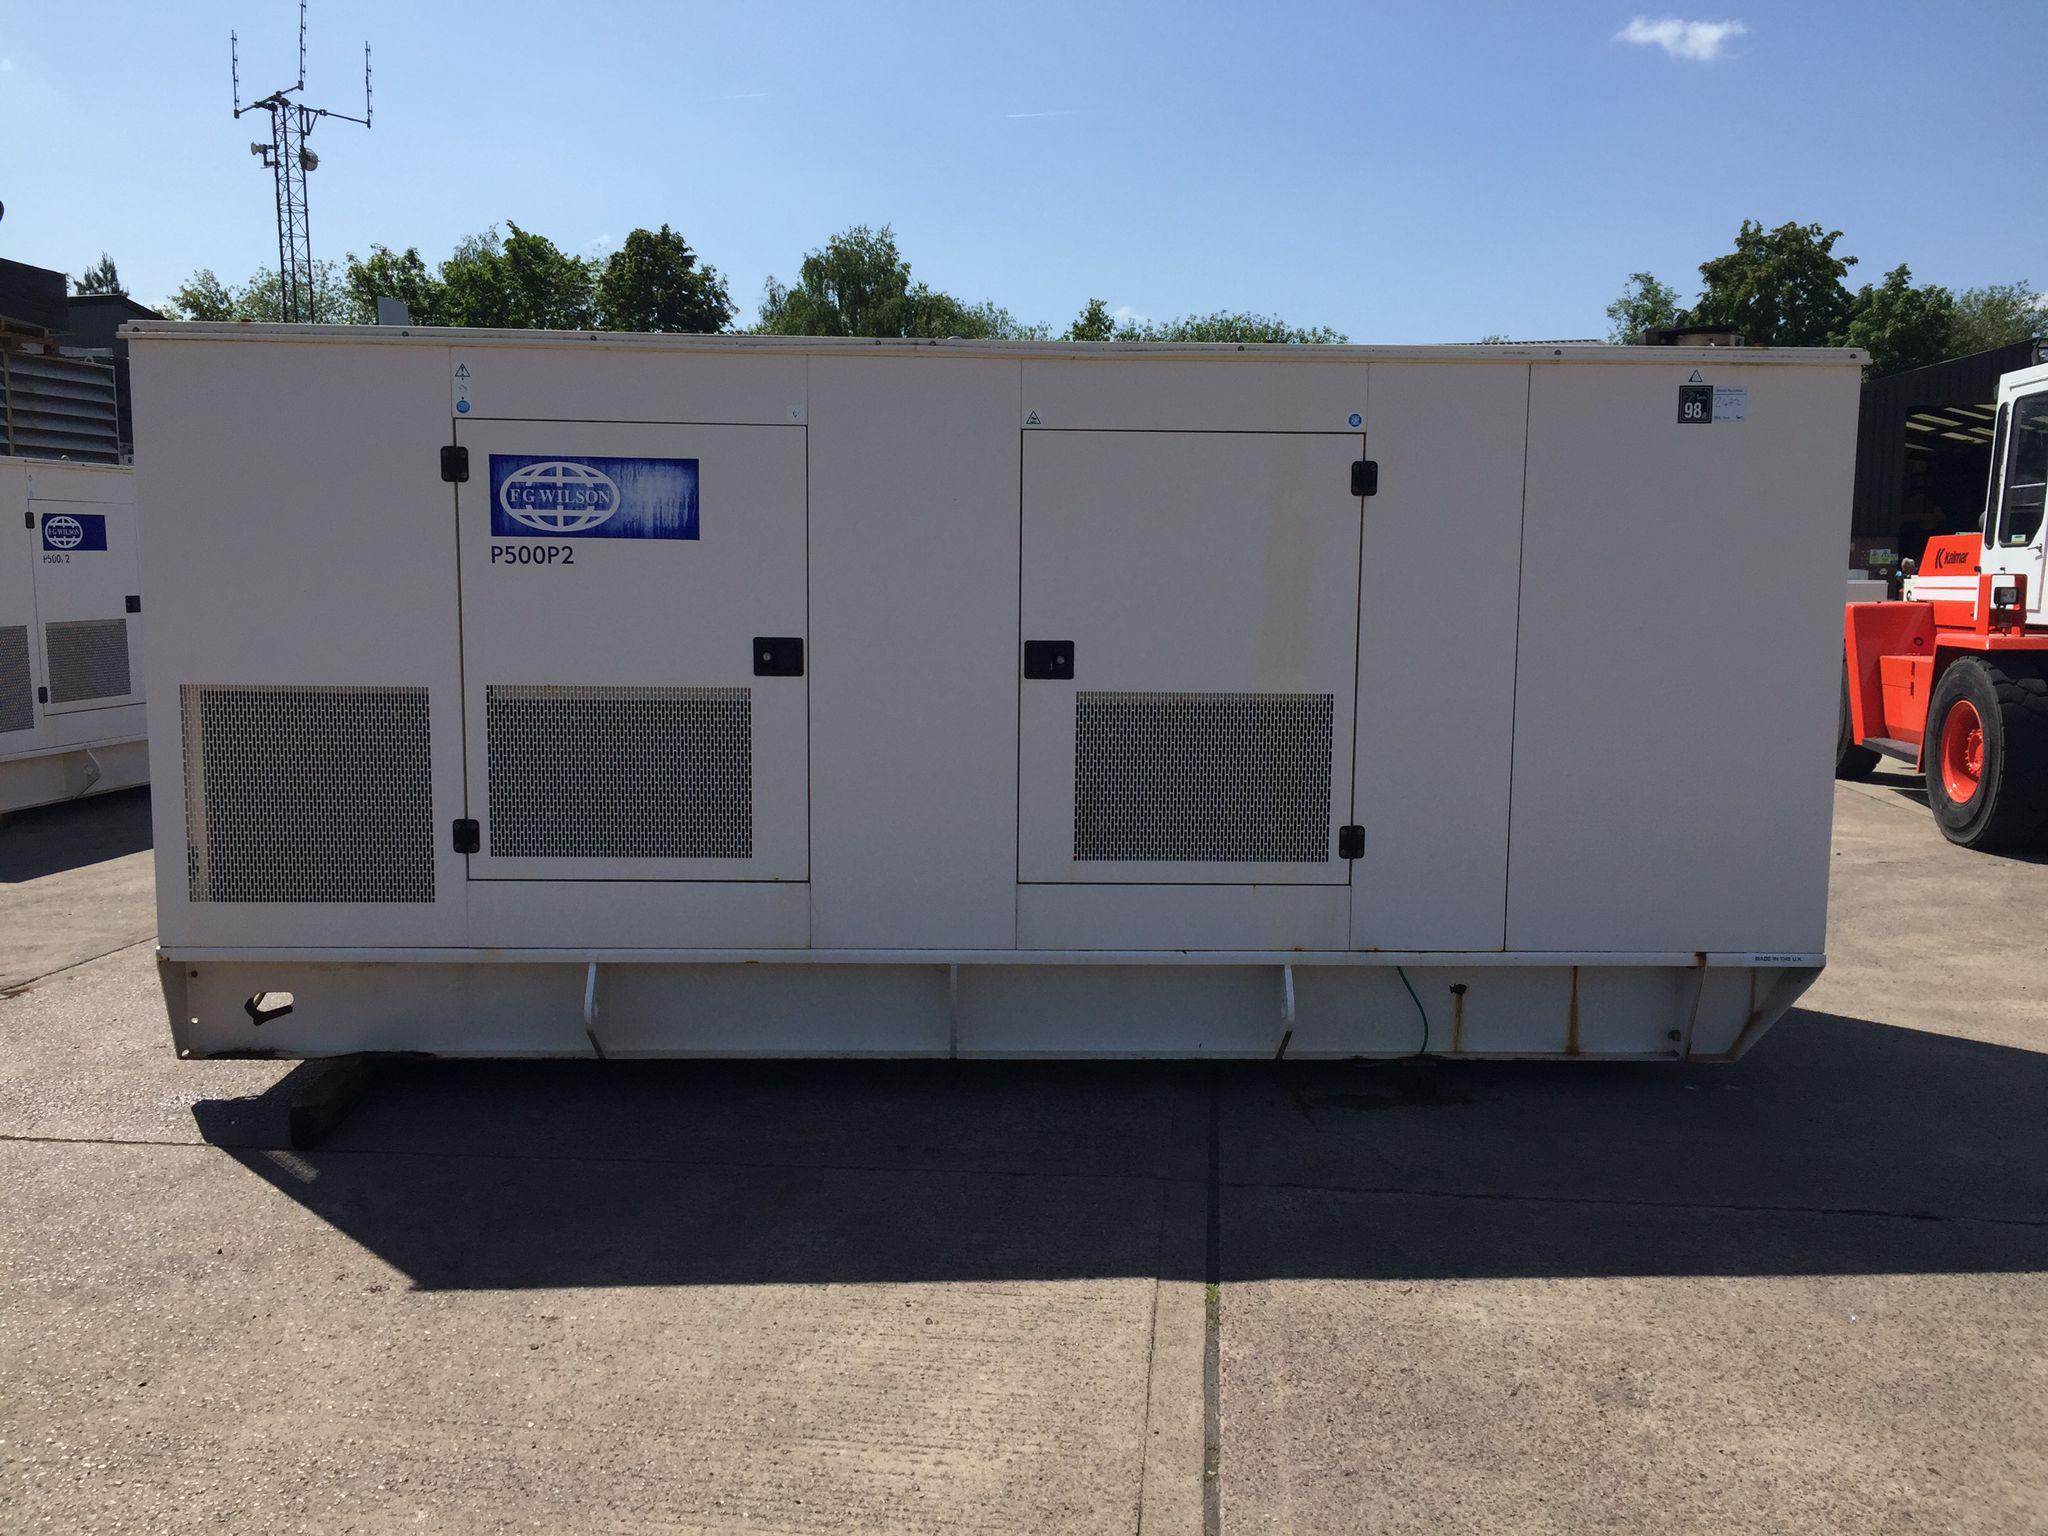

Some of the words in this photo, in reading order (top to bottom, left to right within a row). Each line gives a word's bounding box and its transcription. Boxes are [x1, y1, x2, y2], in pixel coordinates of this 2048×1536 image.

[1684, 402, 1702, 418] 98
[538, 489, 610, 504] WILSON
[491, 545, 574, 565] P500P2
[1944, 551, 1969, 565] Kalmar
